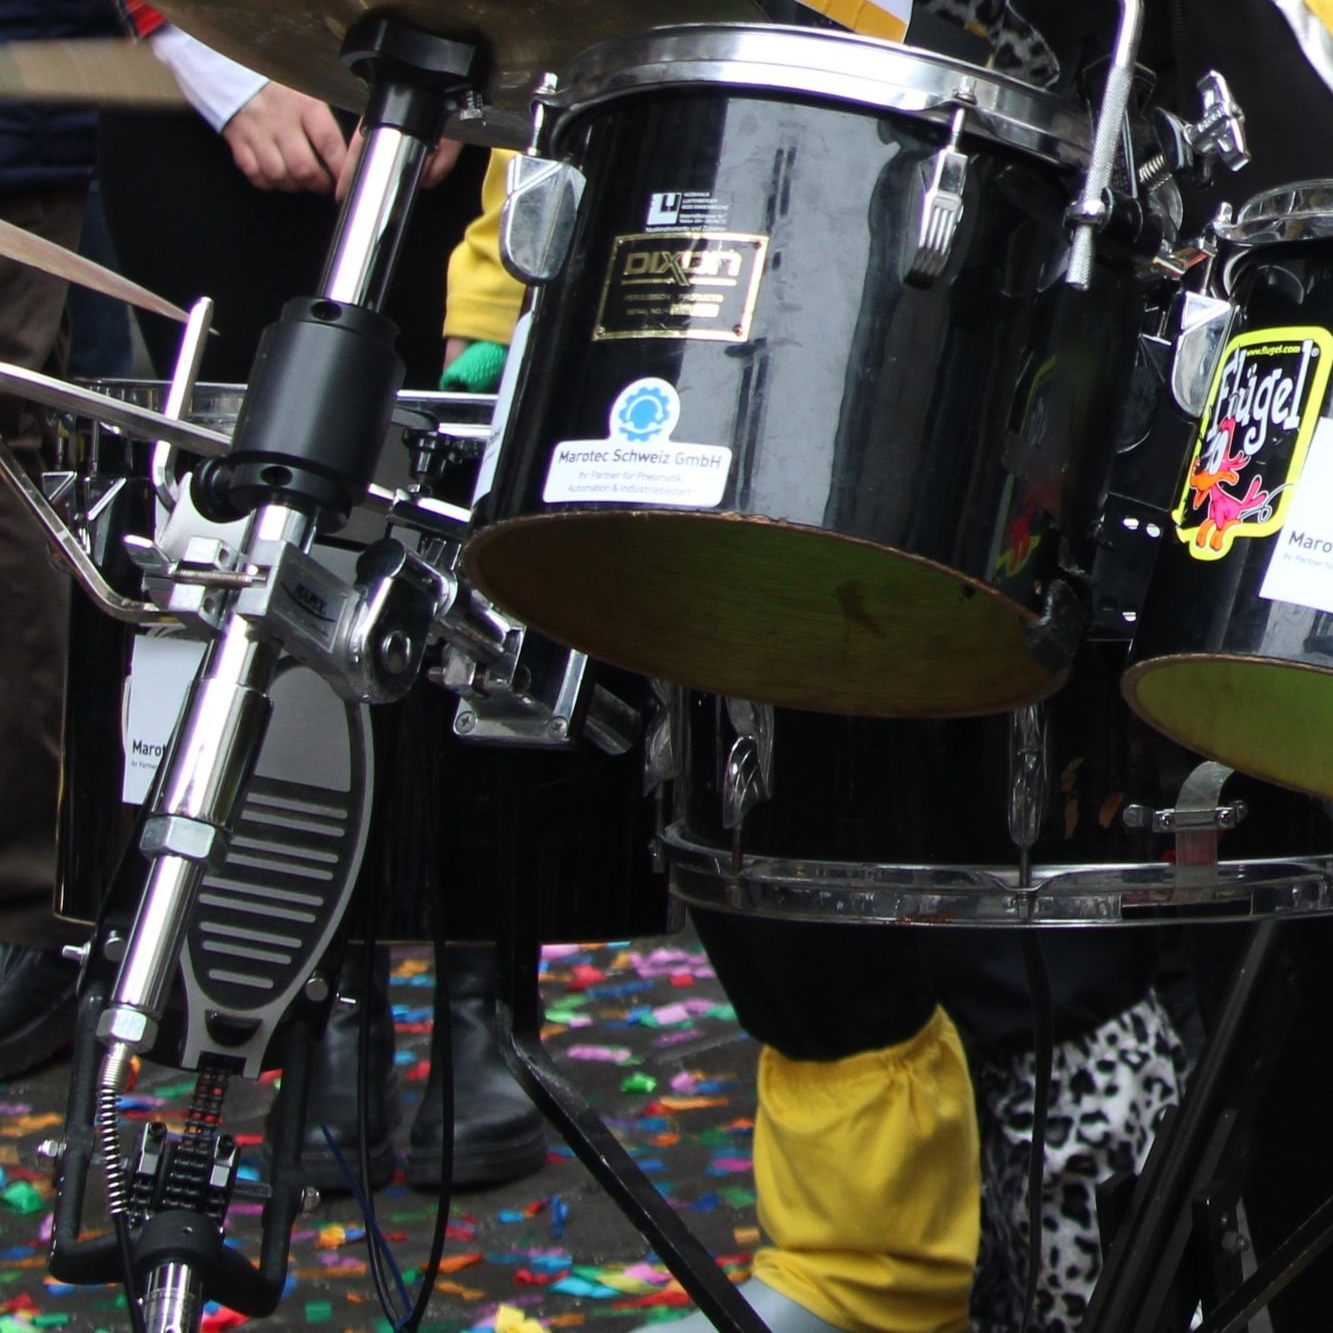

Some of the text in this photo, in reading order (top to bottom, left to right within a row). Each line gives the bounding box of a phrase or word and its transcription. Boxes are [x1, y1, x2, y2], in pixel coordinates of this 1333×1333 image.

[558, 448, 723, 469] Marotec Schweiz GmbH
